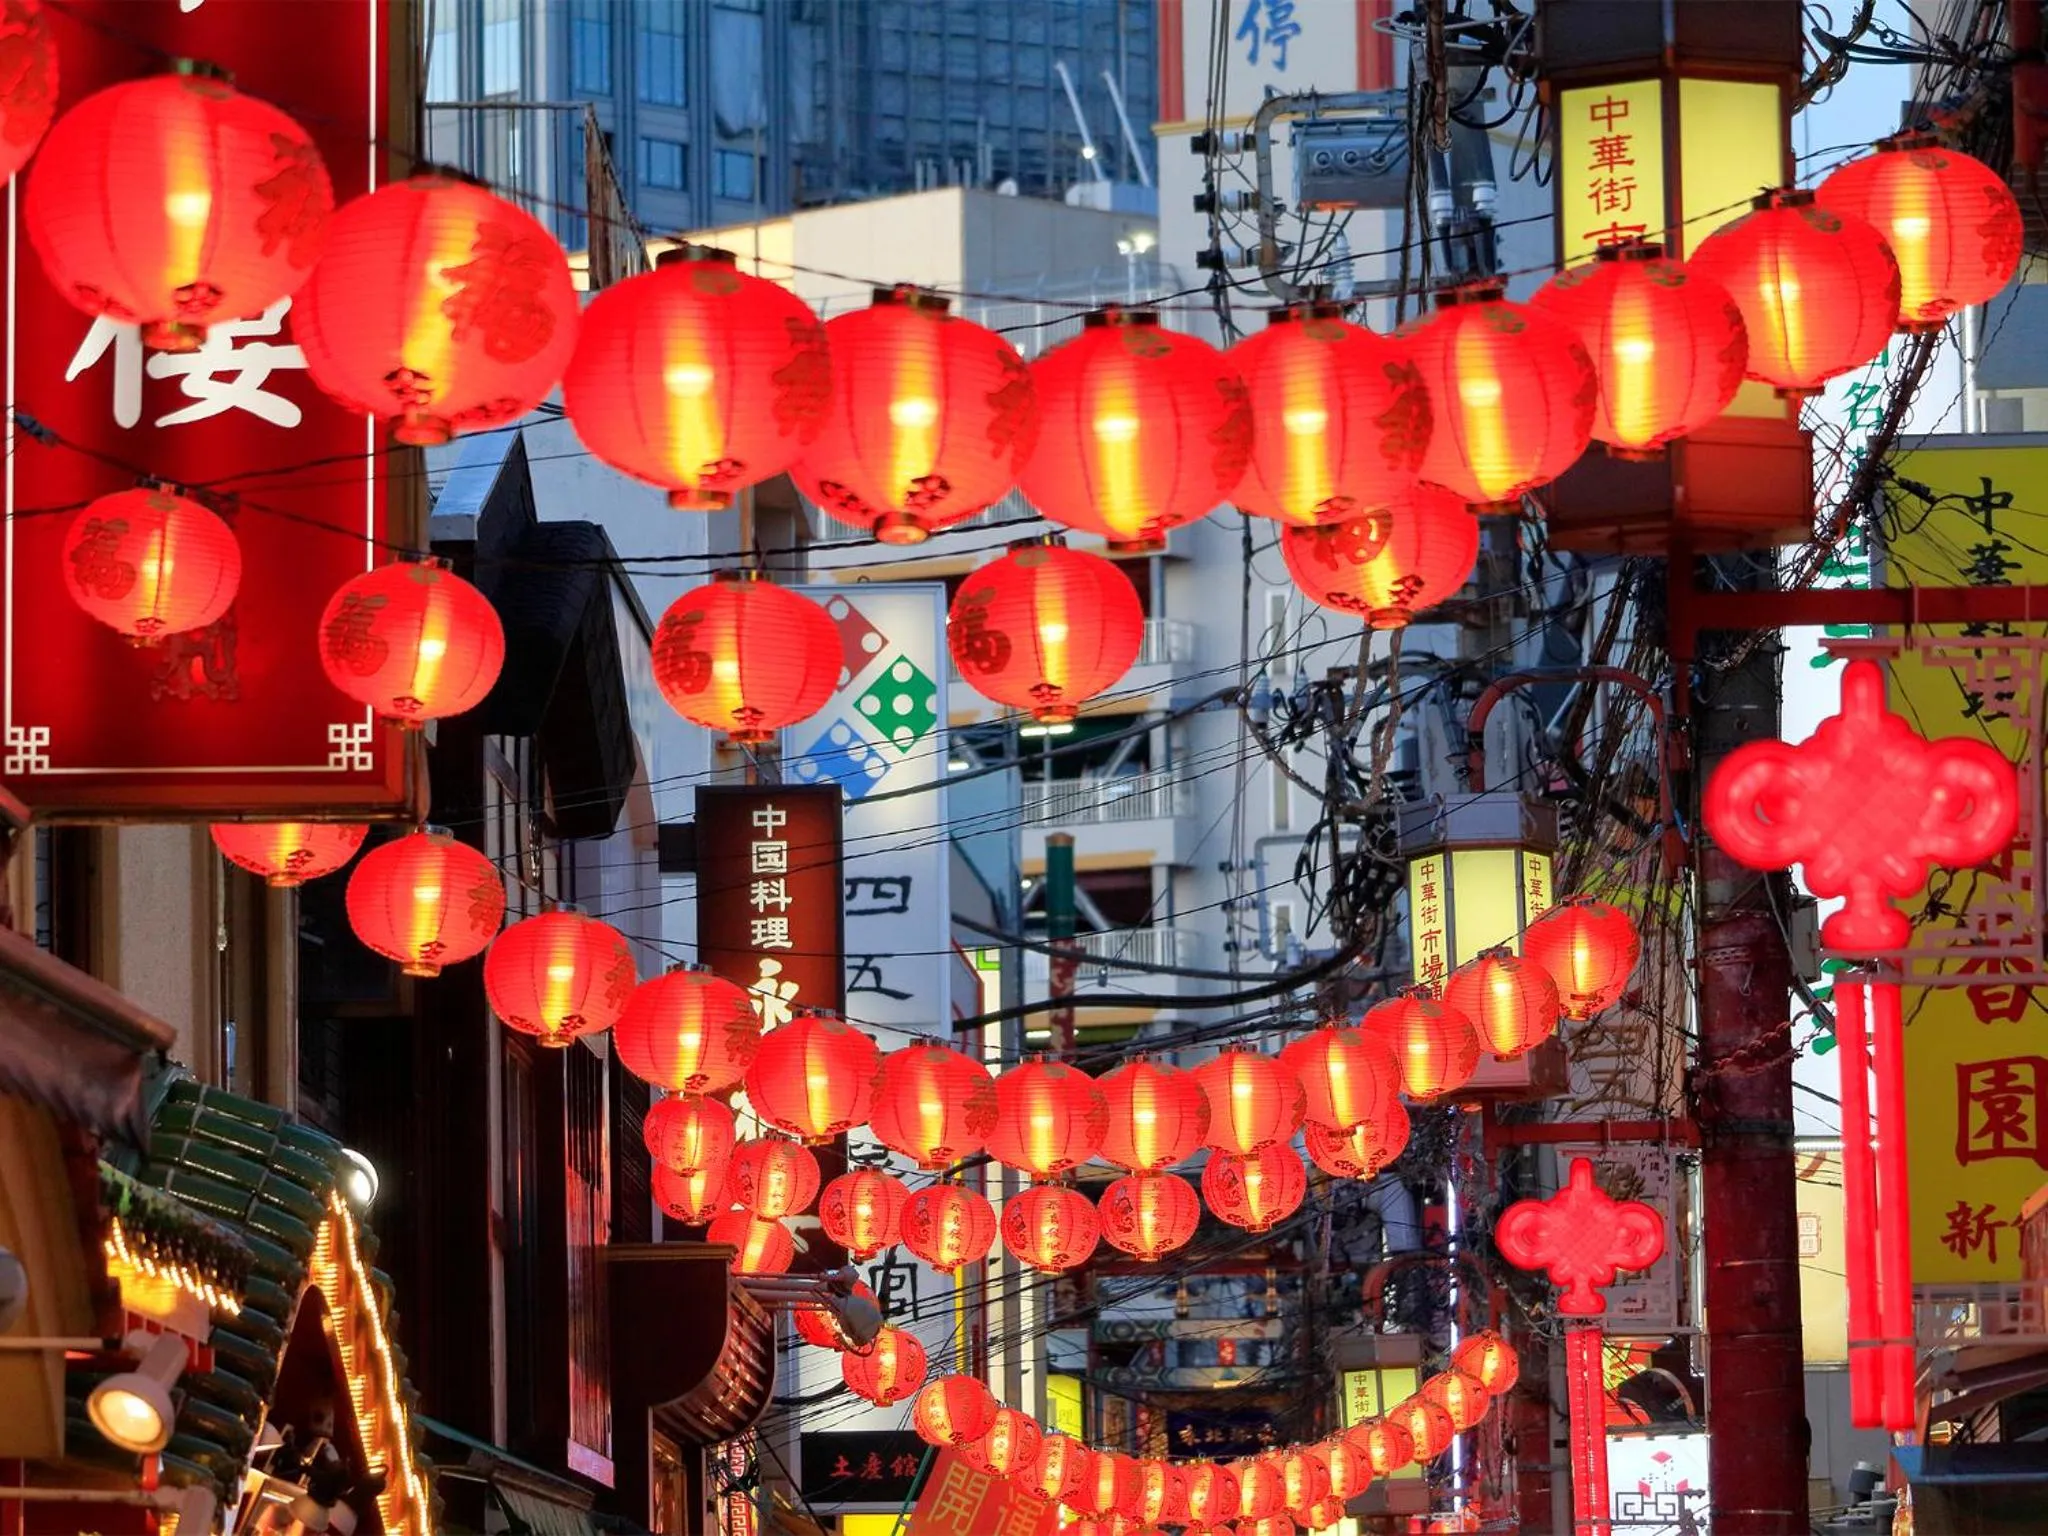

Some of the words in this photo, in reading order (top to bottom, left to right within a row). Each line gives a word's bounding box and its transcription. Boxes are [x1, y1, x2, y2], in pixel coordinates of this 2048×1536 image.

[750, 804, 793, 949] 中国料理
[1940, 1200, 2024, 1265] 新
[1353, 1374, 1370, 1421] 中華街
